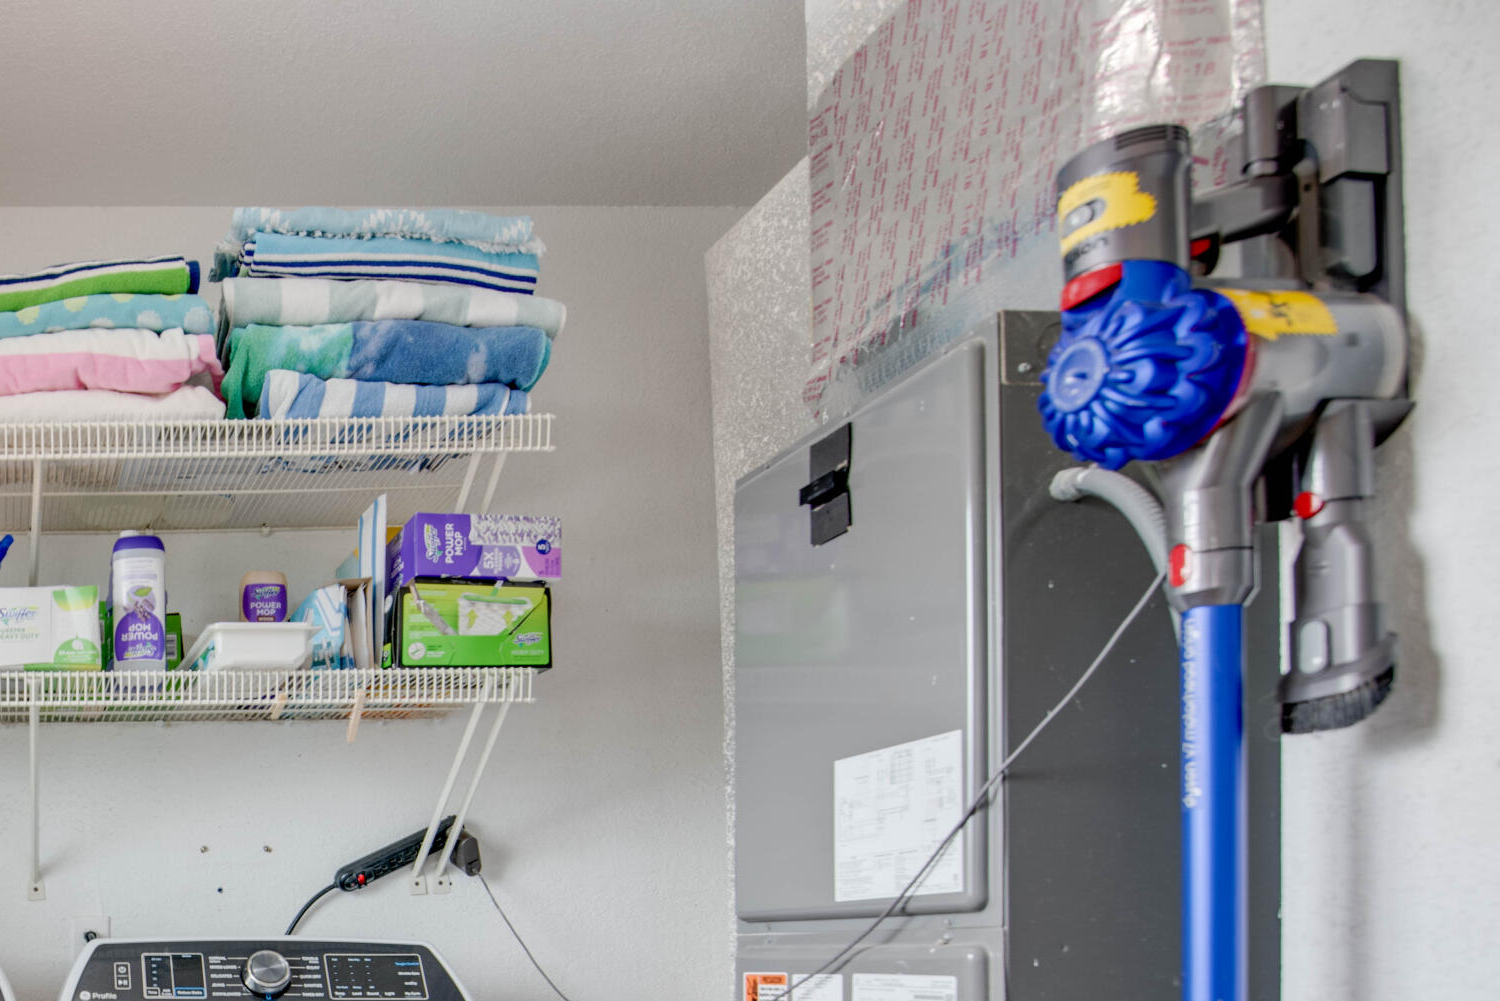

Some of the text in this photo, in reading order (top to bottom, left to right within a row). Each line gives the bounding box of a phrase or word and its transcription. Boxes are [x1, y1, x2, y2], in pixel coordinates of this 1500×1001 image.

[445, 523, 455, 563] POWER
[454, 531, 463, 556] MOP
[484, 552, 494, 569] 5X
[128, 623, 151, 633] MOP
[122, 631, 159, 642] POWER
[92, 992, 117, 1000] Profile
